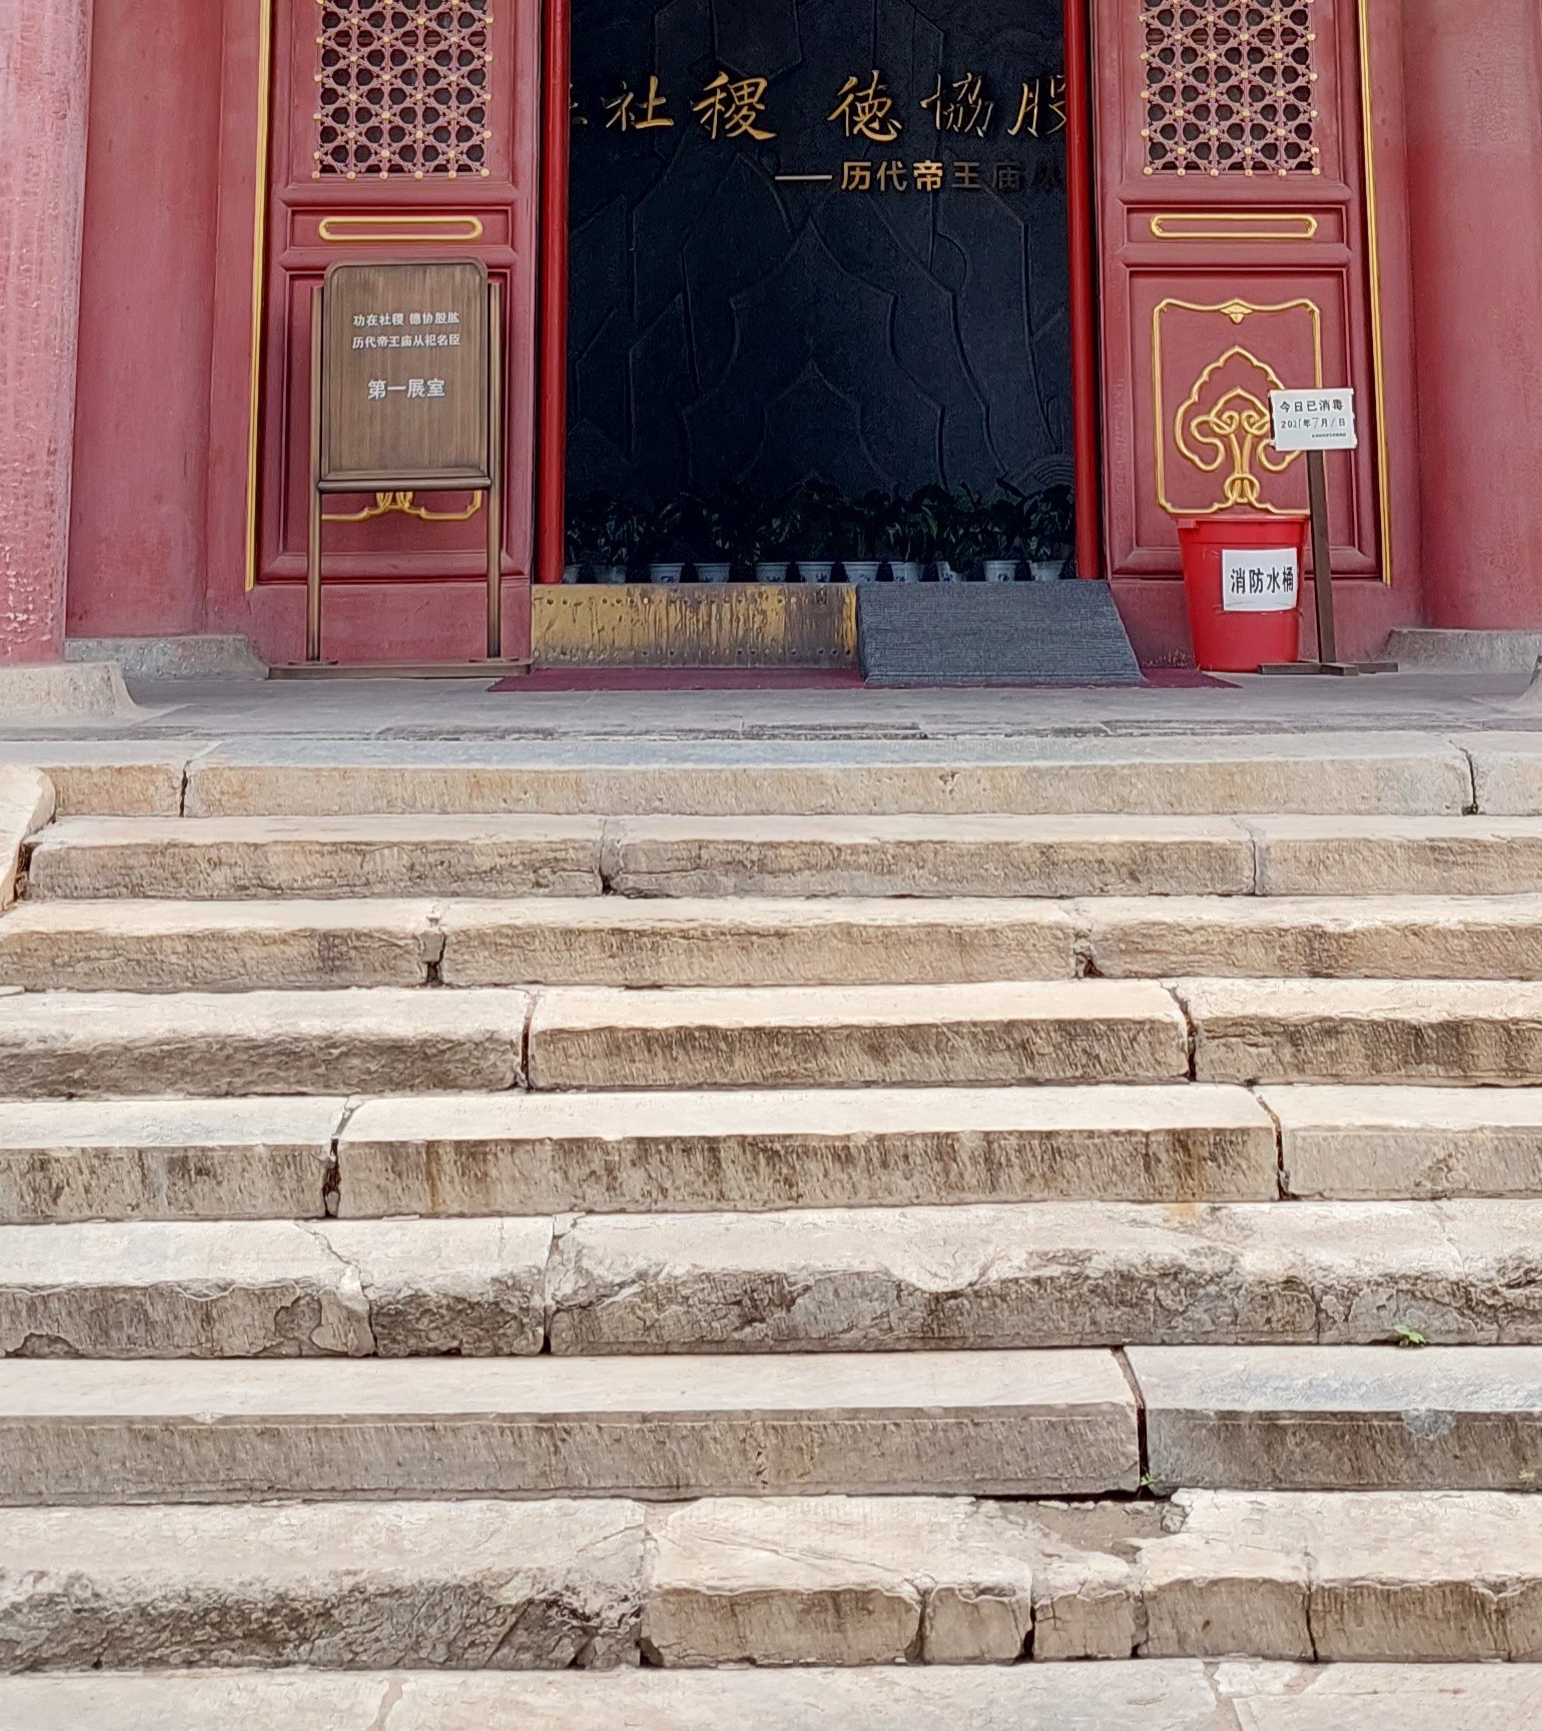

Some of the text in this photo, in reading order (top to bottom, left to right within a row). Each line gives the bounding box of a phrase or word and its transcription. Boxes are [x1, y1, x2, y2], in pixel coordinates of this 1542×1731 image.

[569, 71, 778, 141] 社稷
[352, 313, 404, 327] 功在社稷
[351, 333, 461, 350] 历代帝王庙从祀名臣
[367, 378, 446, 401] 第一展室
[1279, 398, 1343, 413] 今日已消毒
[1230, 566, 1294, 594] 消防水桶
